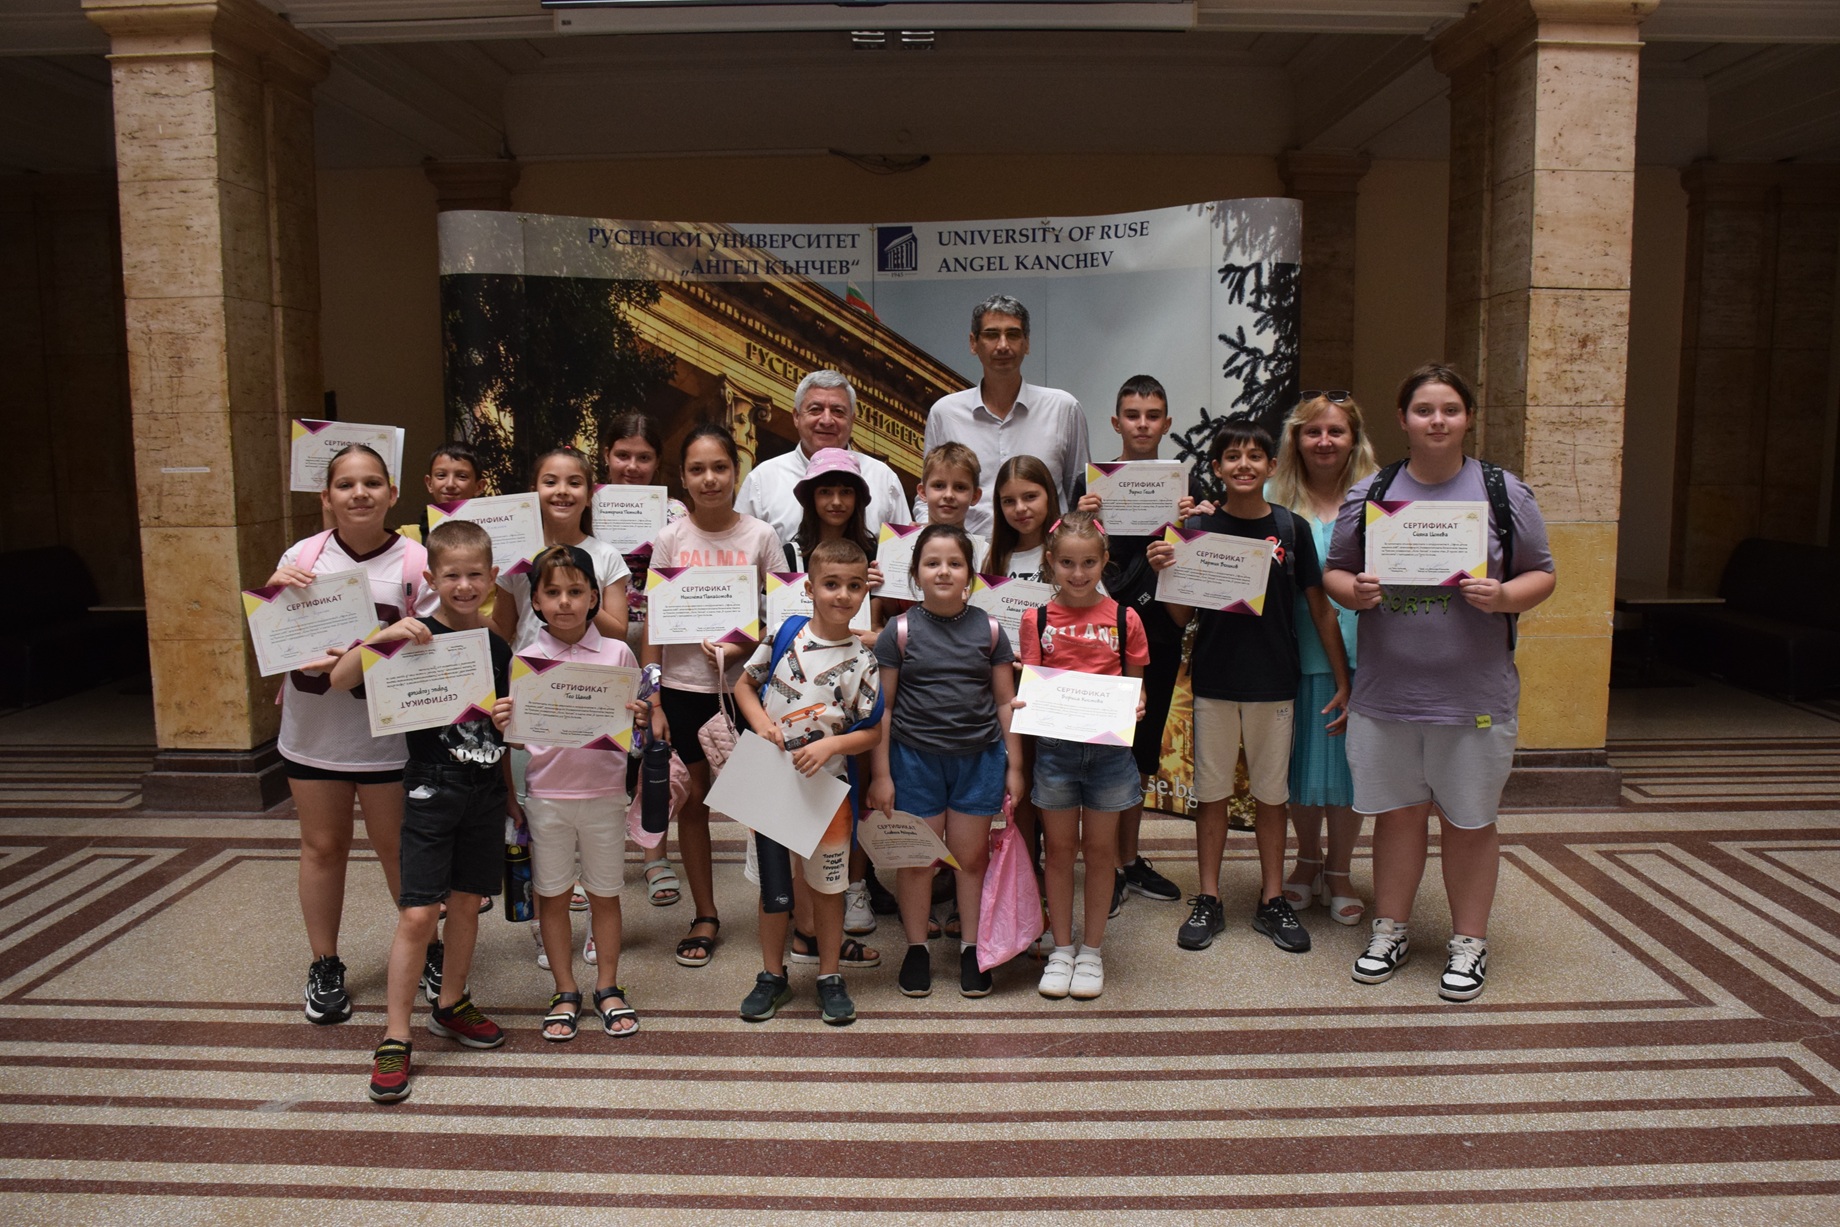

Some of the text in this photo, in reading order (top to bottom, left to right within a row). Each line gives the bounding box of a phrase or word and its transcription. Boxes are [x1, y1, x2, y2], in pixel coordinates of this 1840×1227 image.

[588, 228, 860, 251] РУСЕНСКИ УНИВЕРСИТЕТ
[938, 221, 1150, 246] UNIVERSITY OF RUSE
[681, 259, 759, 277] „АНГЕЛ
[938, 251, 1114, 272] ANGEL KANCHEV
[680, 549, 748, 567] PALMA
[1196, 550, 1245, 563] СЕРТИФИКАТ
[286, 594, 342, 612] СЕРТИФИКАТ
[551, 682, 608, 693] СЕРТИФИКАТ
[1056, 686, 1110, 698] СЕРТИФИКАТ
[401, 693, 458, 709] СЕРТИФИКАТ
